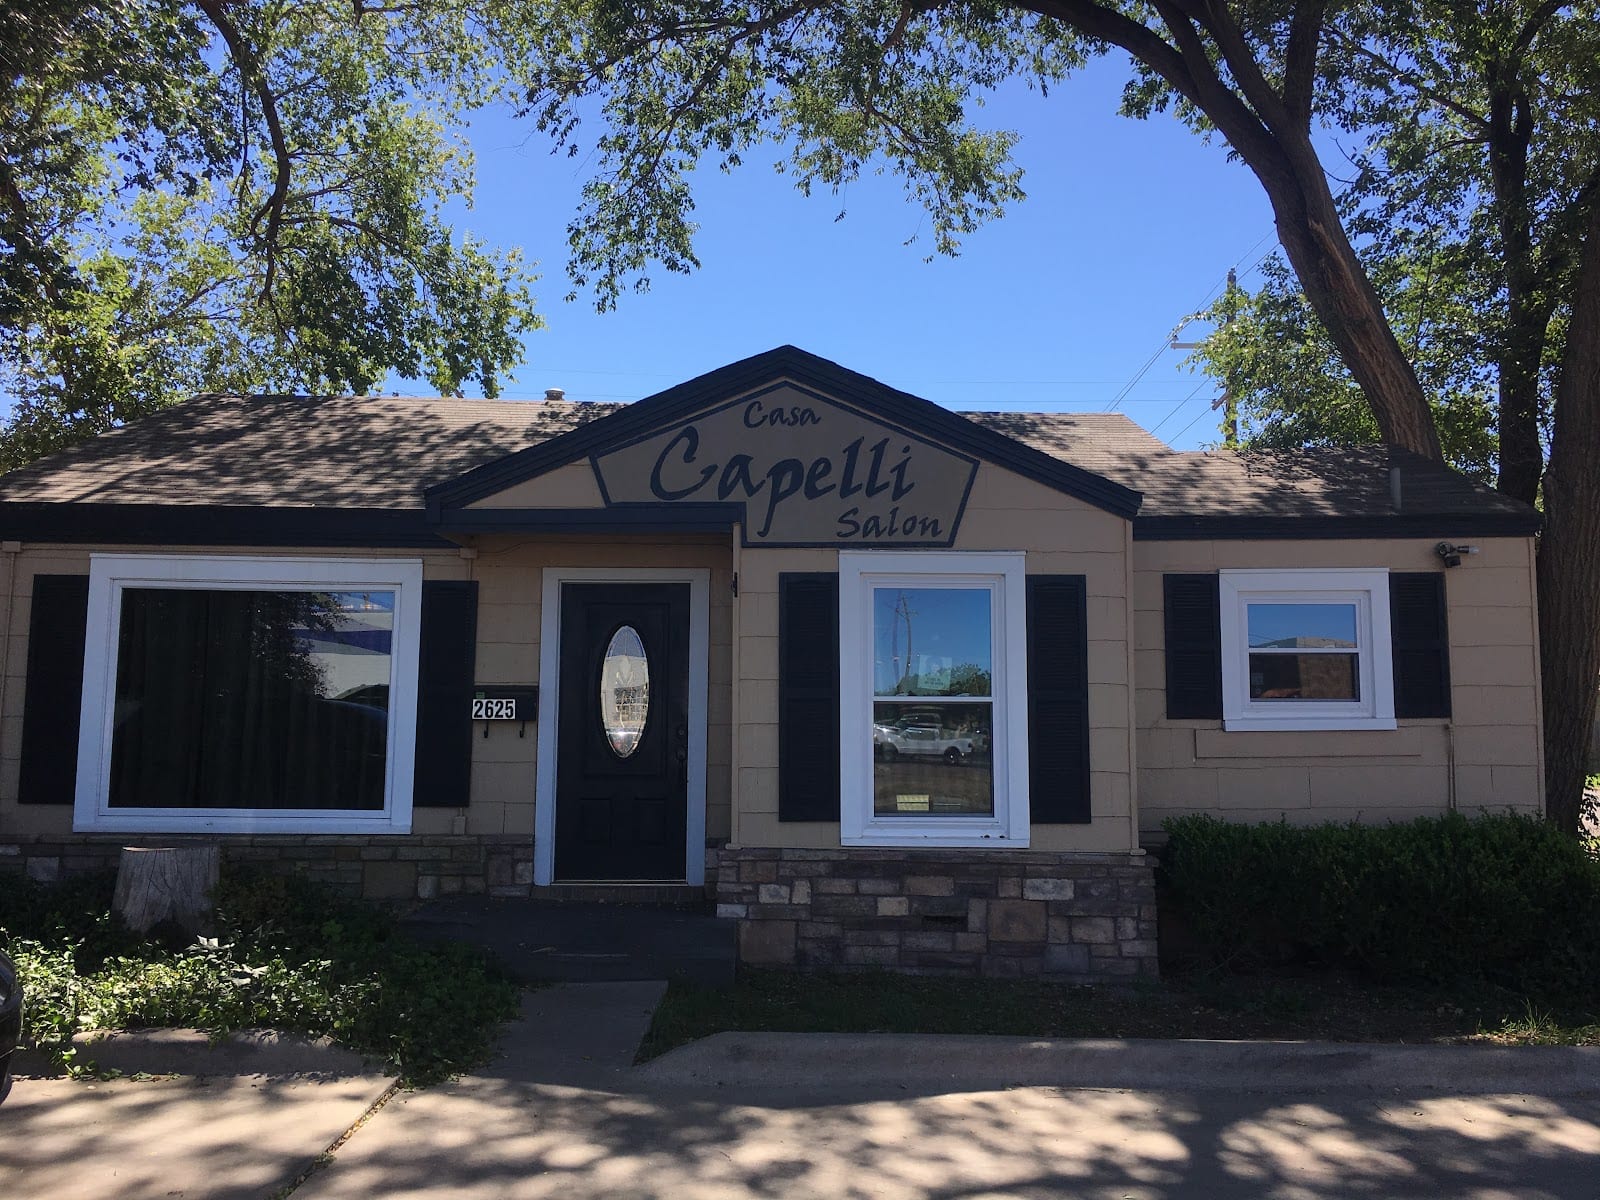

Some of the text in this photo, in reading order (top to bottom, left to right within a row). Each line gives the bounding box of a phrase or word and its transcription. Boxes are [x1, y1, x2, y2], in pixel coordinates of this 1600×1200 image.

[743, 401, 821, 428] Casa
[649, 426, 915, 537] Capelli
[836, 507, 942, 538] Salon
[473, 700, 514, 718] 2625
